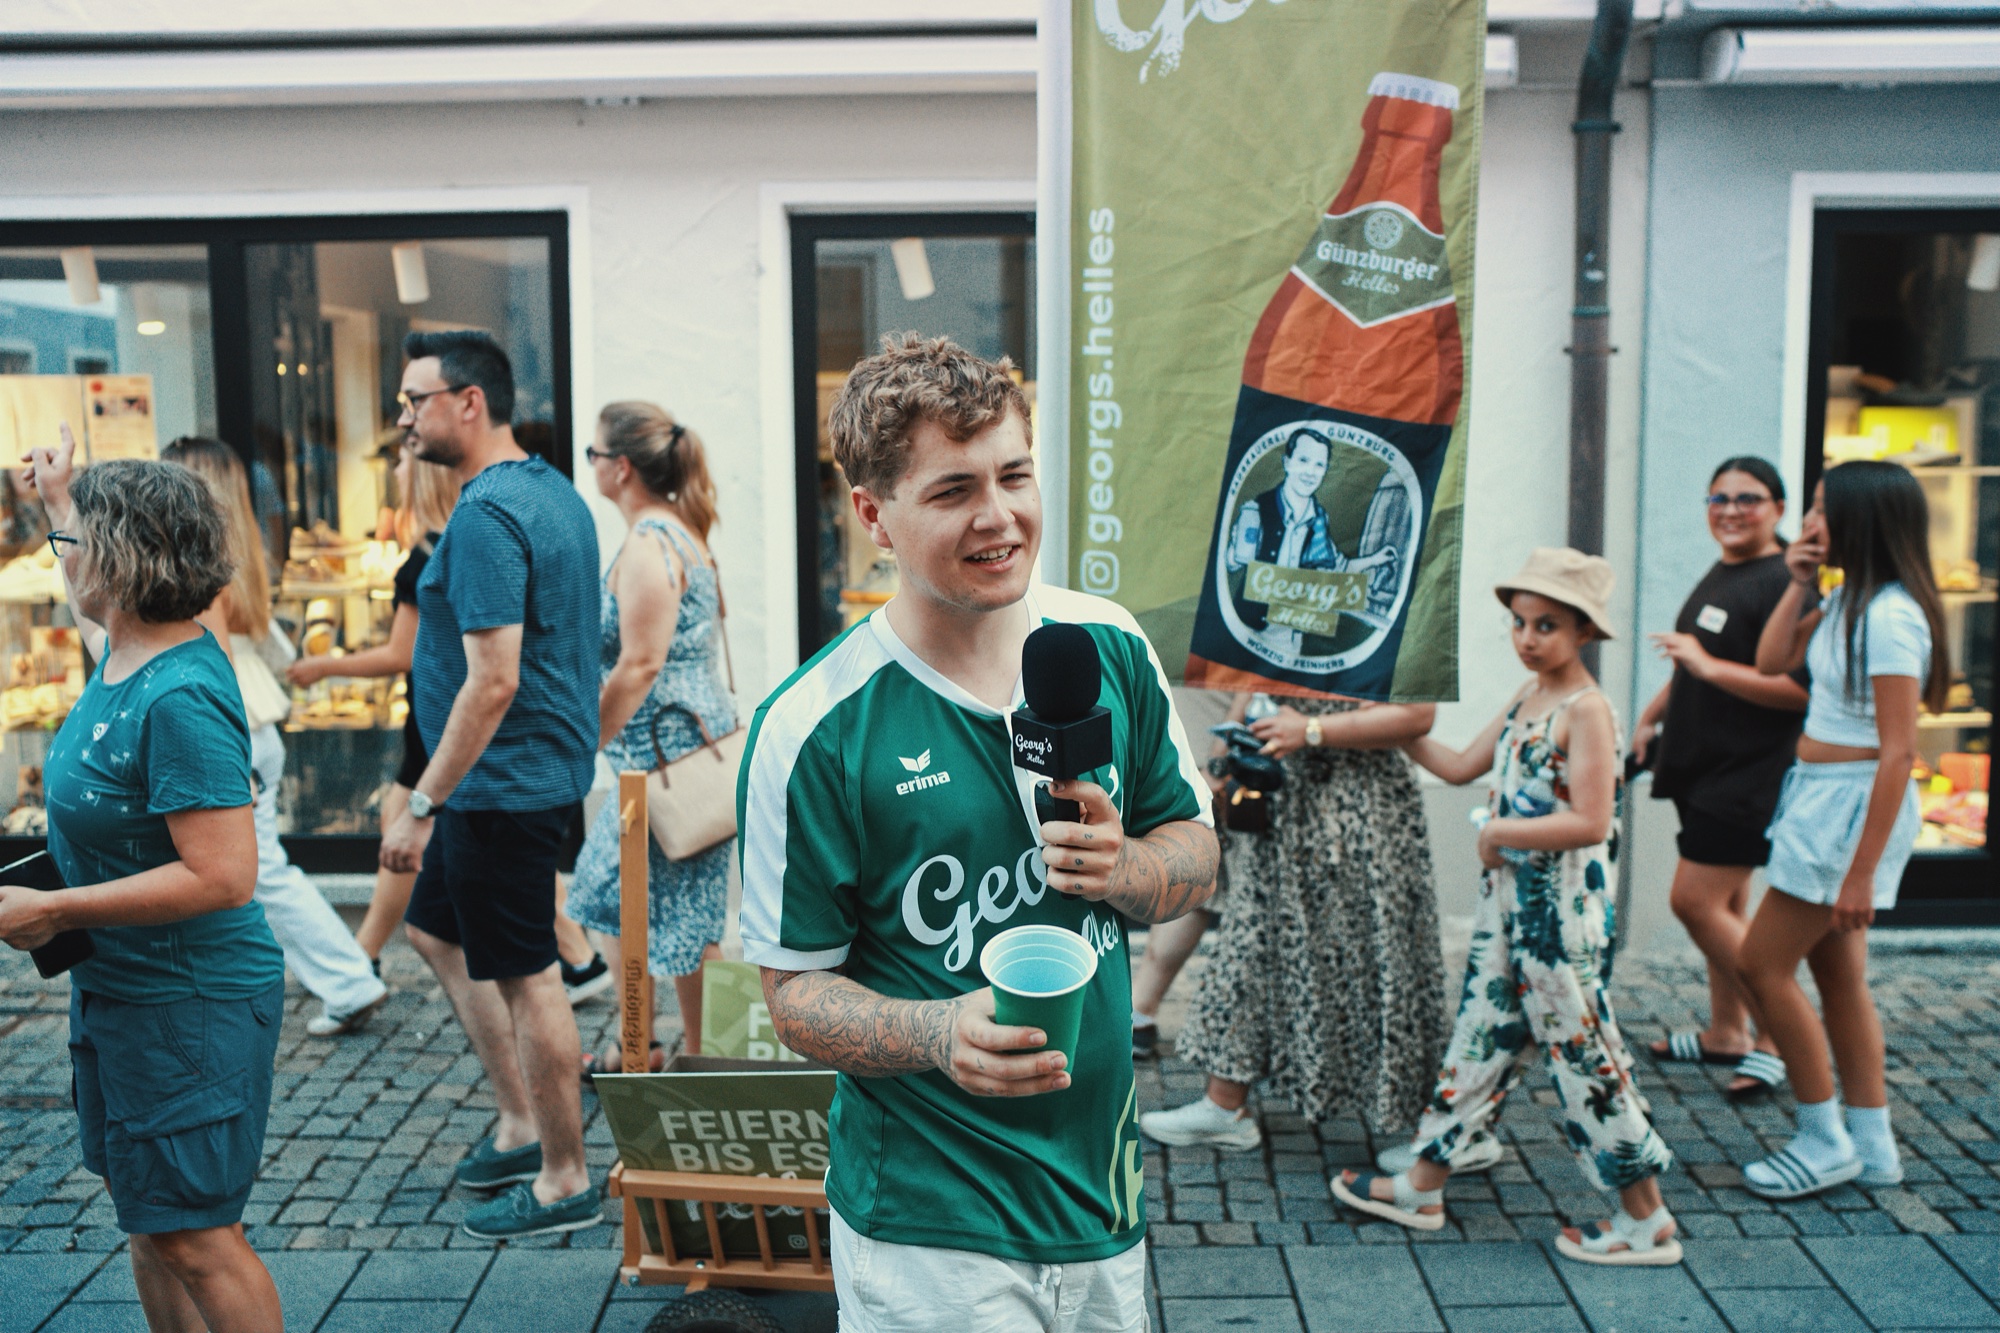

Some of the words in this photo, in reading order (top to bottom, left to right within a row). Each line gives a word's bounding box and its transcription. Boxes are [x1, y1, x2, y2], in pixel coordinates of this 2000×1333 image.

[1316, 240, 1440, 281] Günzburger
[1341, 269, 1400, 295] Helles
[1082, 207, 1123, 543] georgs.helles
[1250, 565, 1362, 613] Georg's
[1271, 606, 1330, 632] Helles
[1015, 733, 1053, 756] Georg's
[1026, 752, 1045, 766] Helles
[895, 770, 951, 796] erima
[1081, 909, 1119, 957] lles
[659, 1109, 830, 1141] FEIERN
[668, 1142, 755, 1172] BIS
[768, 1142, 831, 1172] ES
